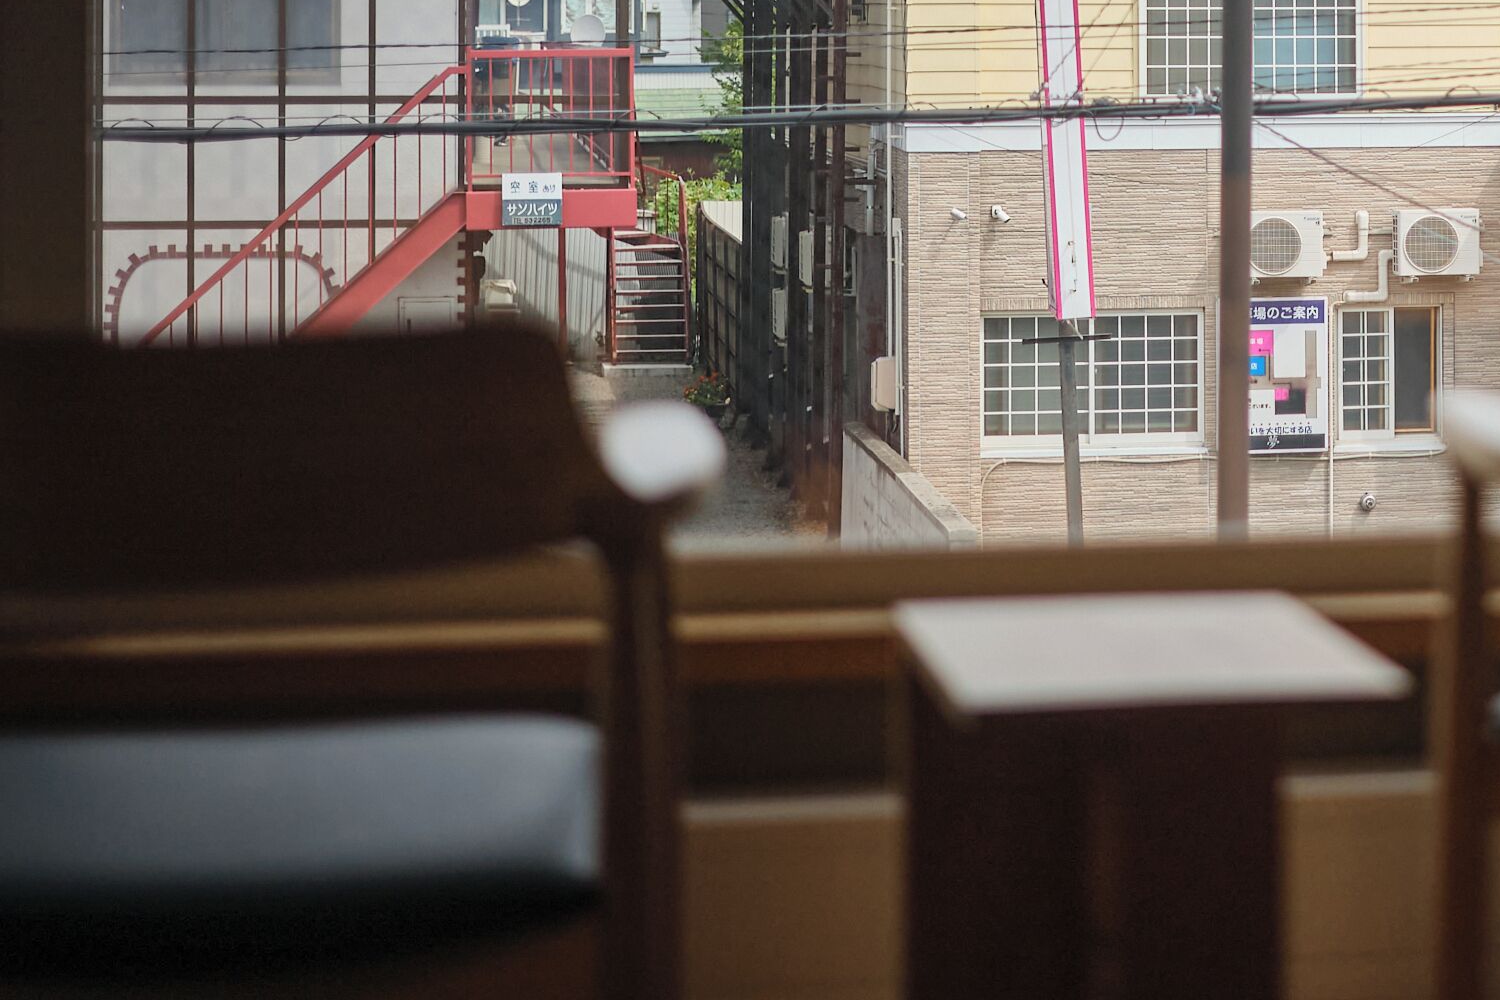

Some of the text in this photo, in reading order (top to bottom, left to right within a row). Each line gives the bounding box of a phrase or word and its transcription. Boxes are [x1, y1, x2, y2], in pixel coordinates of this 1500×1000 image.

[507, 203, 558, 215] サンハイツ
